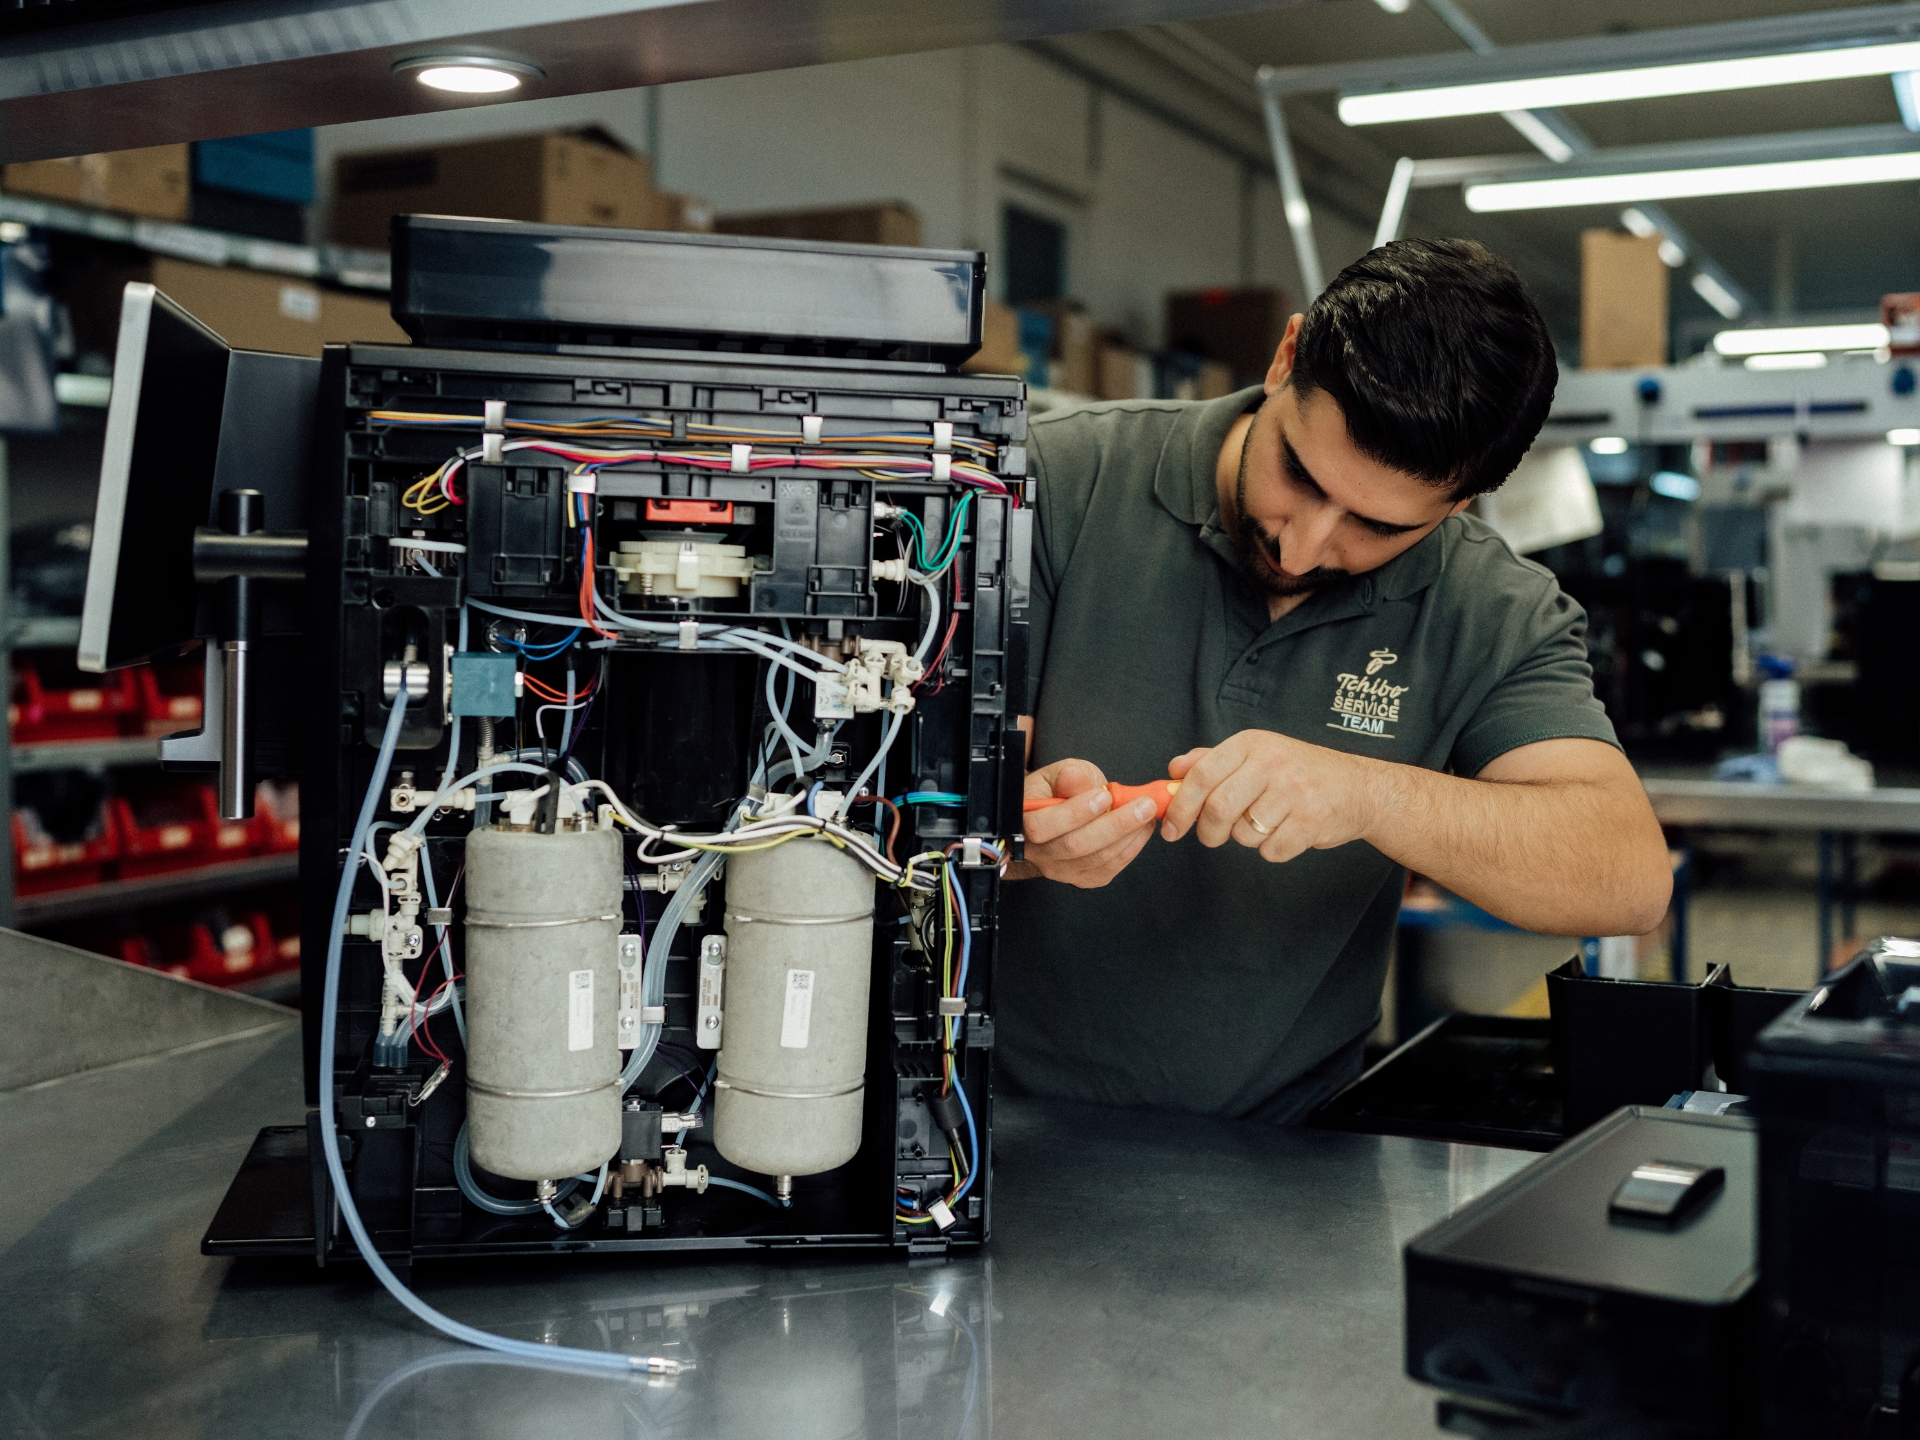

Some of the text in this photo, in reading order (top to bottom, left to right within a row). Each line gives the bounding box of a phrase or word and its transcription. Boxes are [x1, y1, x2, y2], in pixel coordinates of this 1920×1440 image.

[1337, 673, 1409, 698] Tchibo
[1333, 695, 1400, 718] SERVICE
[1341, 713, 1385, 734] TEAM
